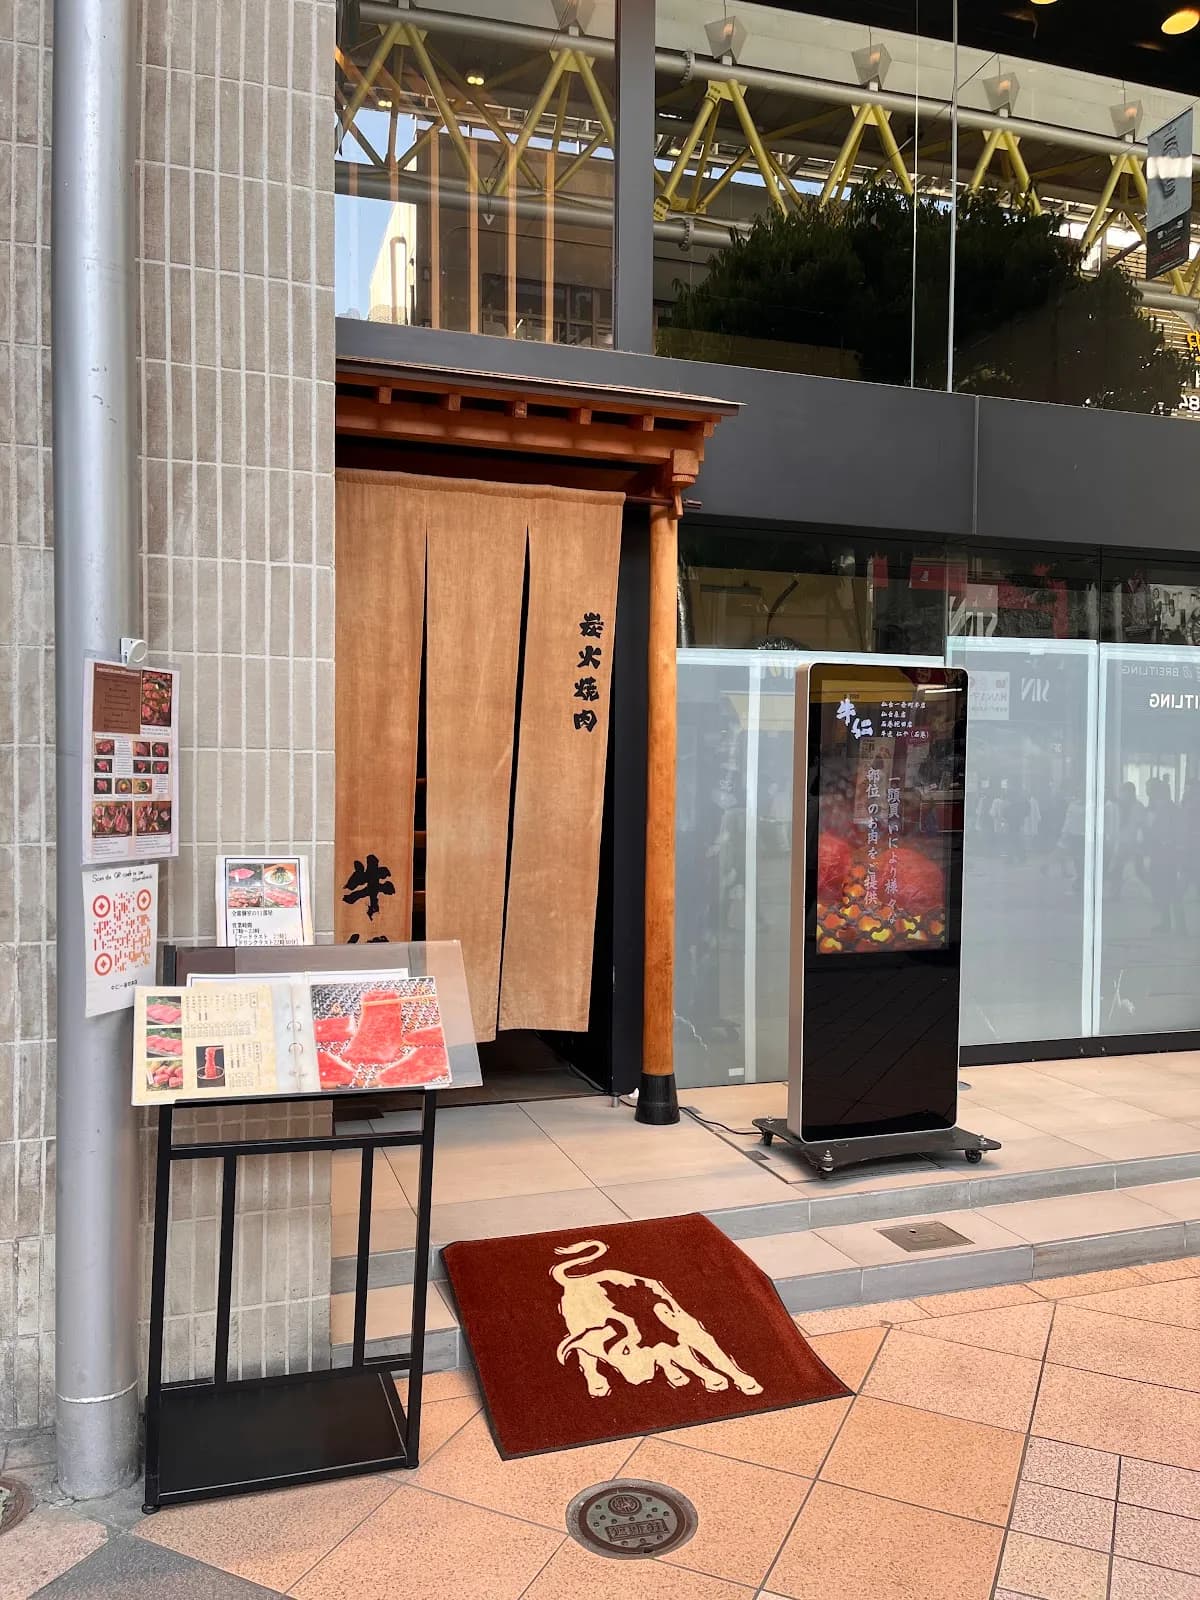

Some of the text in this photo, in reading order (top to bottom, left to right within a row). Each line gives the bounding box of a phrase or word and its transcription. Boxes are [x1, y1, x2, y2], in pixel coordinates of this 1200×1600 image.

[864, 768, 880, 905] 部位のお肉をご提供
